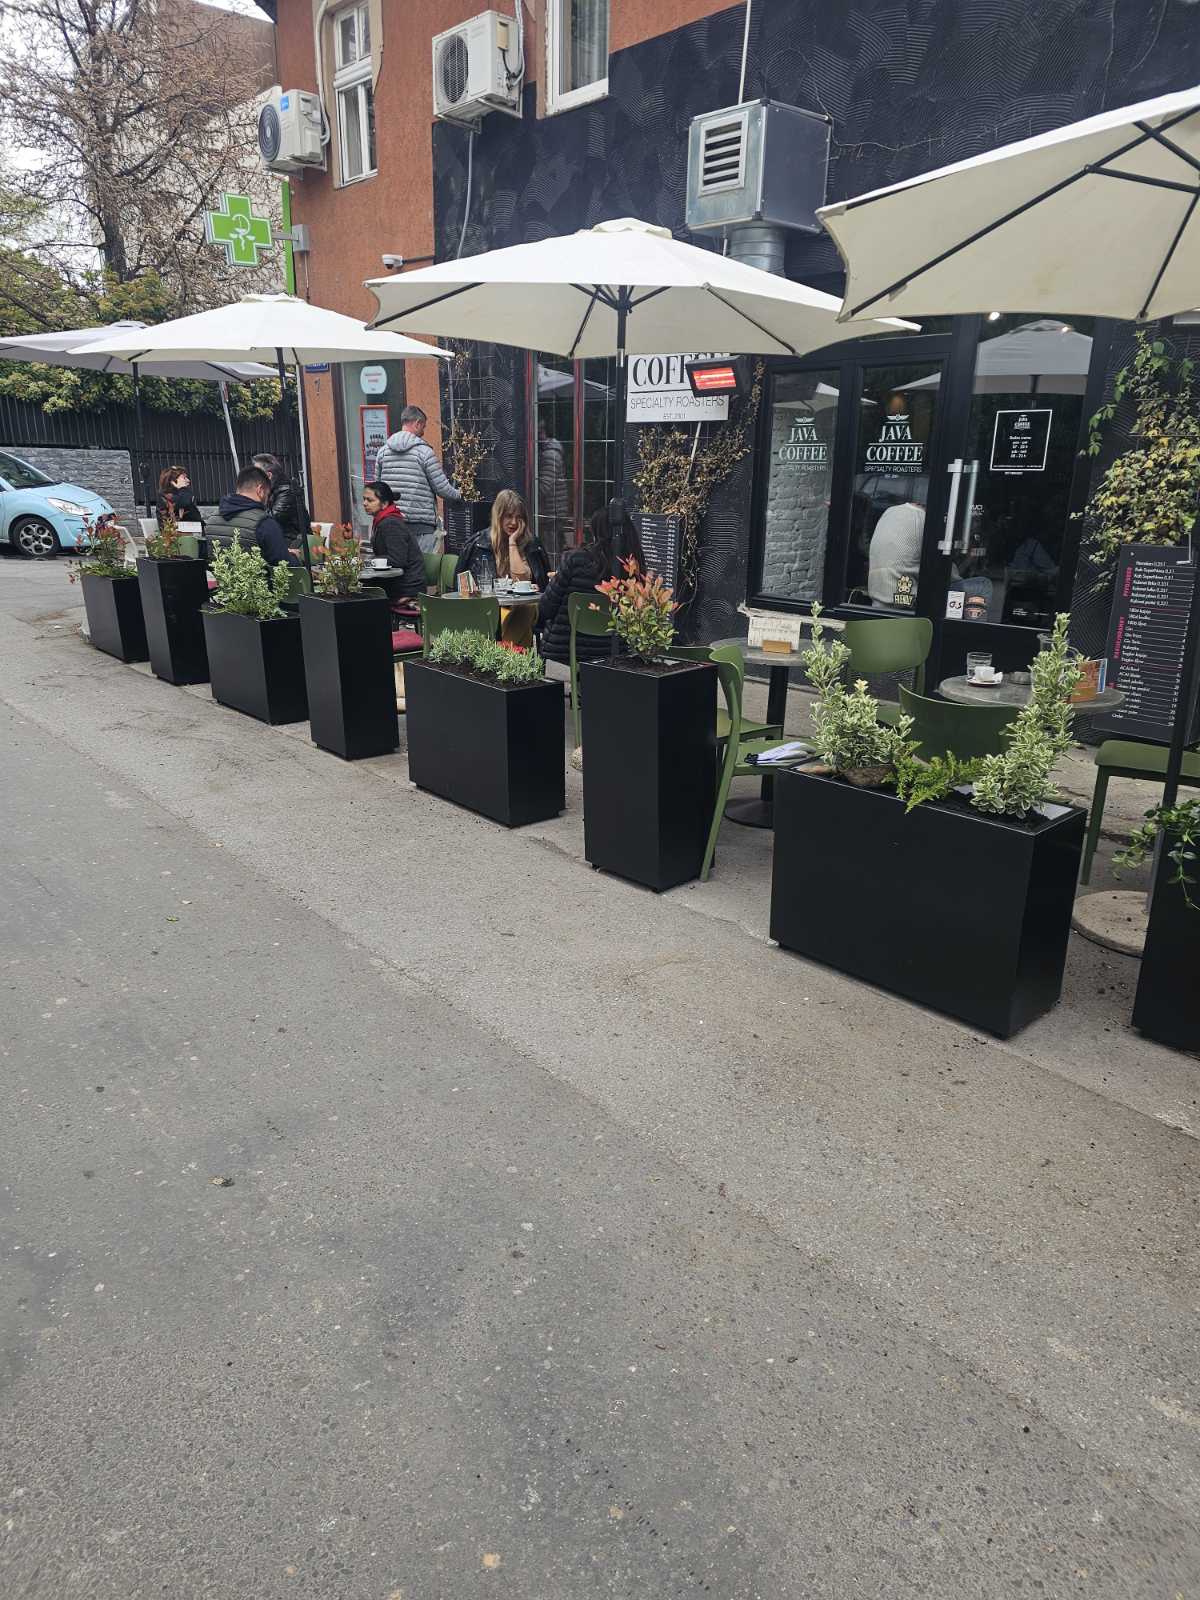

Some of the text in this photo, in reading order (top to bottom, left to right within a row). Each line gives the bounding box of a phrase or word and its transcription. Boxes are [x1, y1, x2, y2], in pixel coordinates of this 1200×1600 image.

[633, 353, 730, 387] COFF
[630, 395, 726, 410] SPECIALTY ROASTERS
[788, 427, 818, 443] JAVA
[879, 425, 912, 442] JAVA
[778, 446, 827, 461] COFFEE
[866, 446, 924, 461] COFFEE
